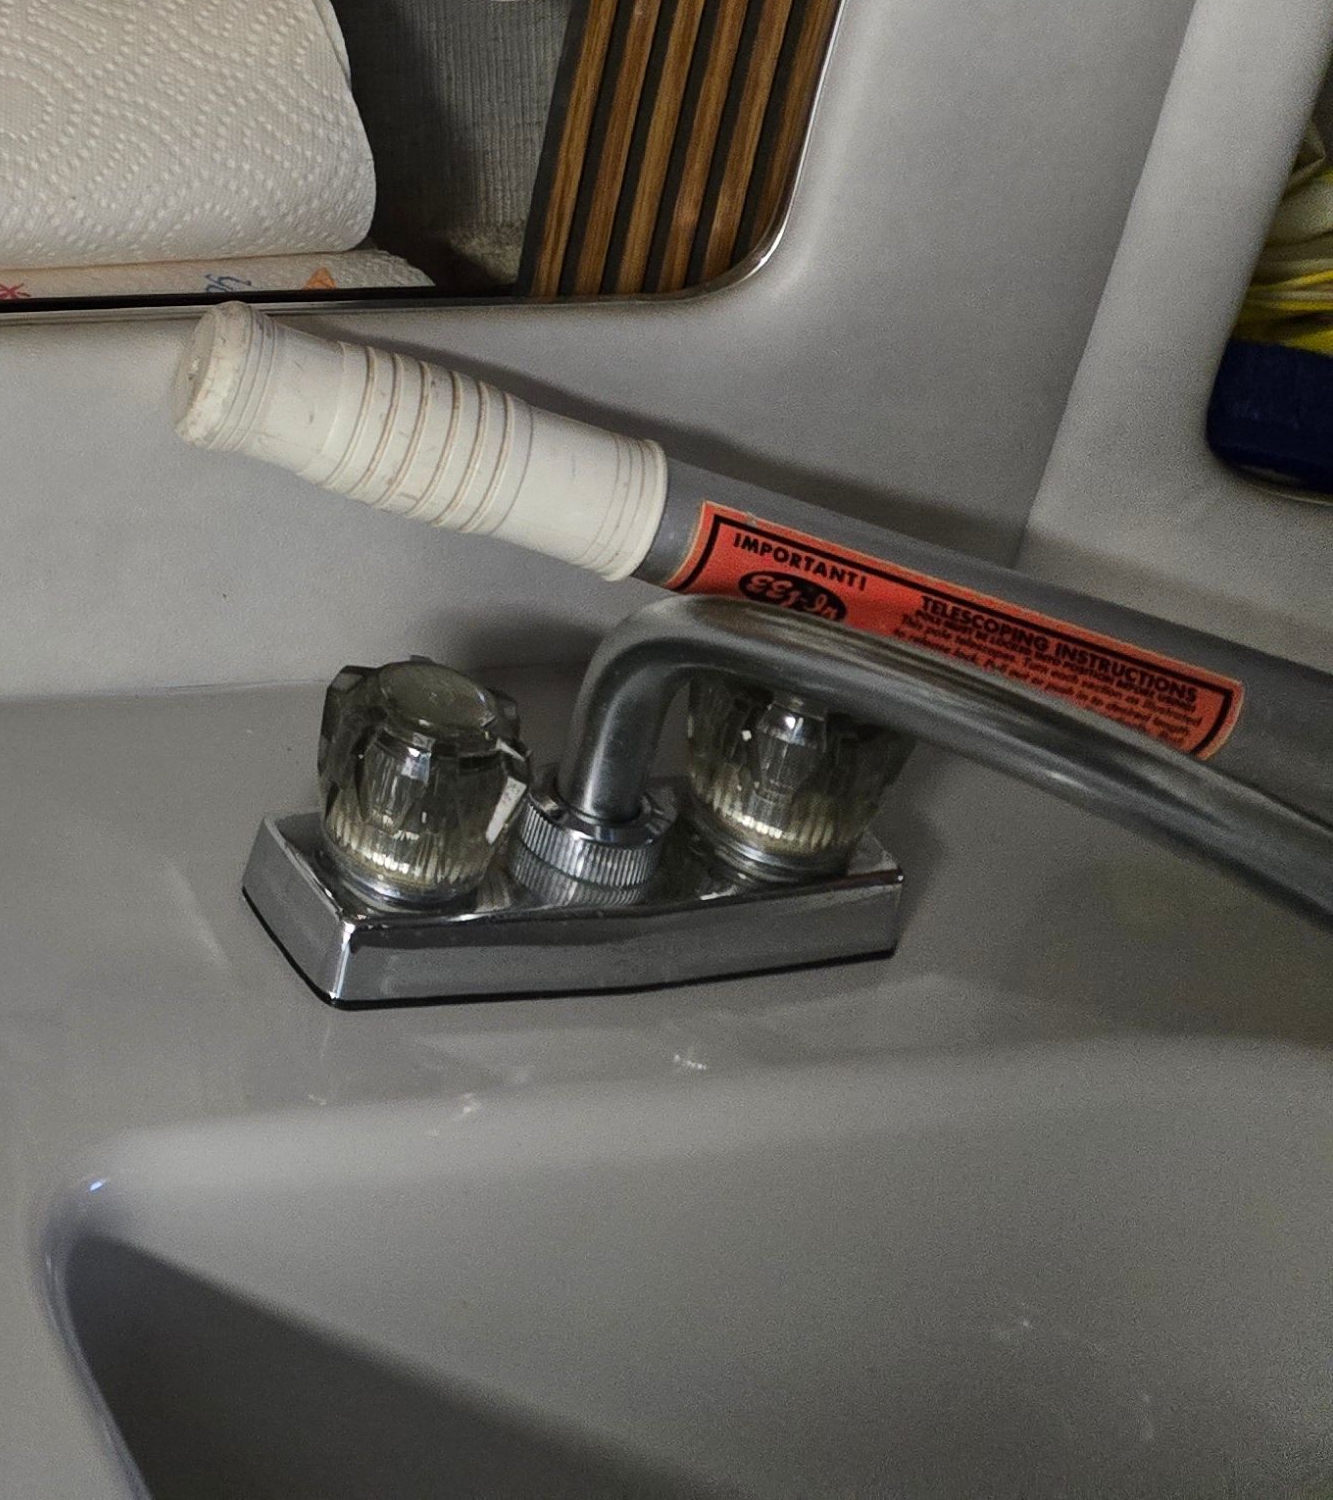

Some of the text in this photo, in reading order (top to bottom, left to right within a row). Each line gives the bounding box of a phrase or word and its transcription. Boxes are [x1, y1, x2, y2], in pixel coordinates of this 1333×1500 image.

[733, 532, 867, 591] IMPORTANT!
[918, 595, 1199, 704] TELESCOPING INSTRUCTIONS
